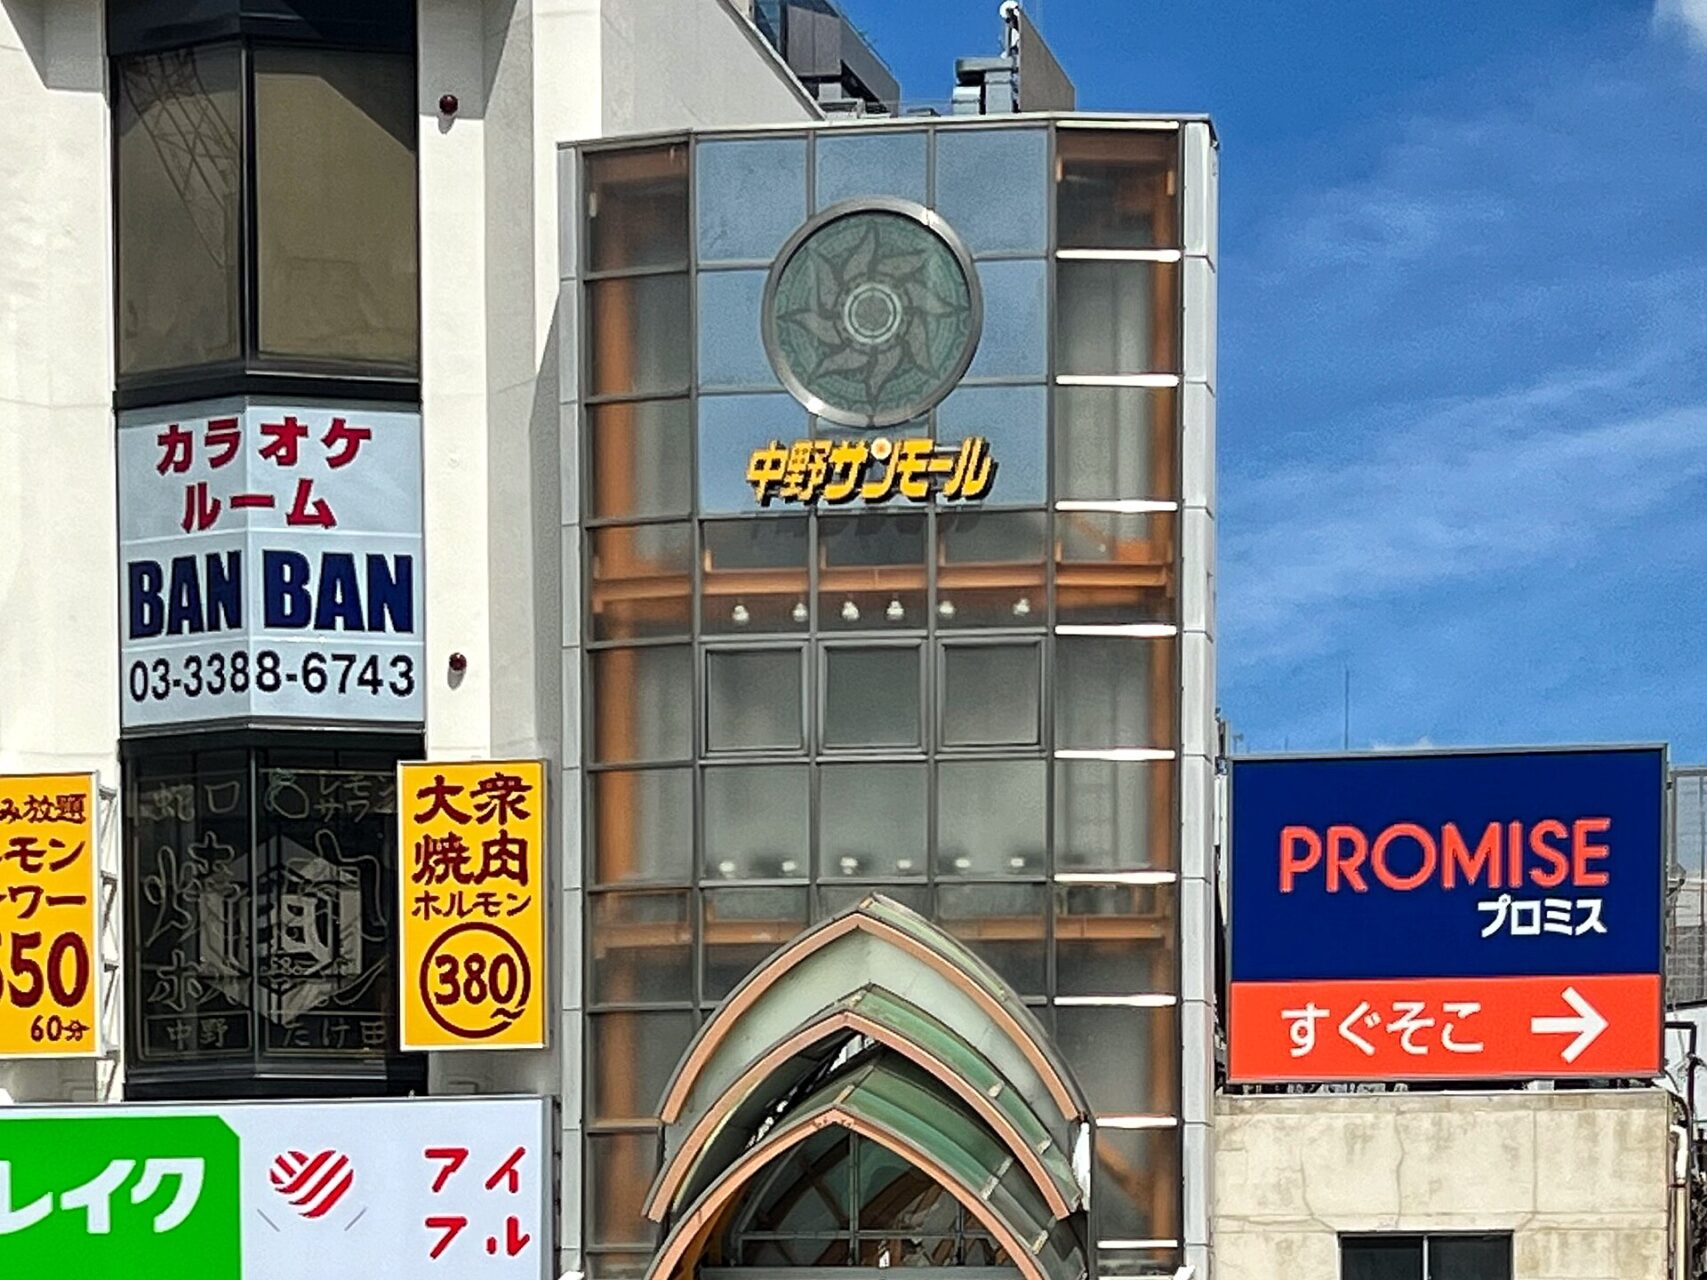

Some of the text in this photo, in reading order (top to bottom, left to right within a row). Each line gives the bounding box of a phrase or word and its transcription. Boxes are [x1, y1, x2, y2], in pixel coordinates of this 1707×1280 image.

[157, 415, 371, 475] カラオケ
[746, 436, 996, 504] 中野サンモール
[181, 478, 337, 533] ルーム
[128, 549, 415, 640] BAN BAN
[129, 651, 416, 702] 03-3388-6743
[415, 771, 533, 826] 大衆
[0, 836, 86, 874] モン
[413, 829, 531, 887] 焼肉
[1279, 816, 1613, 893] PROMISE
[0, 885, 87, 919] ワー
[411, 890, 532, 921] ホルモン
[1477, 893, 1608, 939] プロミス
[0, 931, 90, 1008] 50
[30, 1014, 91, 1042] 60分
[1280, 1001, 1485, 1058] すぐそこ
[0, 1157, 205, 1235] レイク
[423, 1146, 527, 1194] アイ
[424, 1216, 531, 1259] フル
